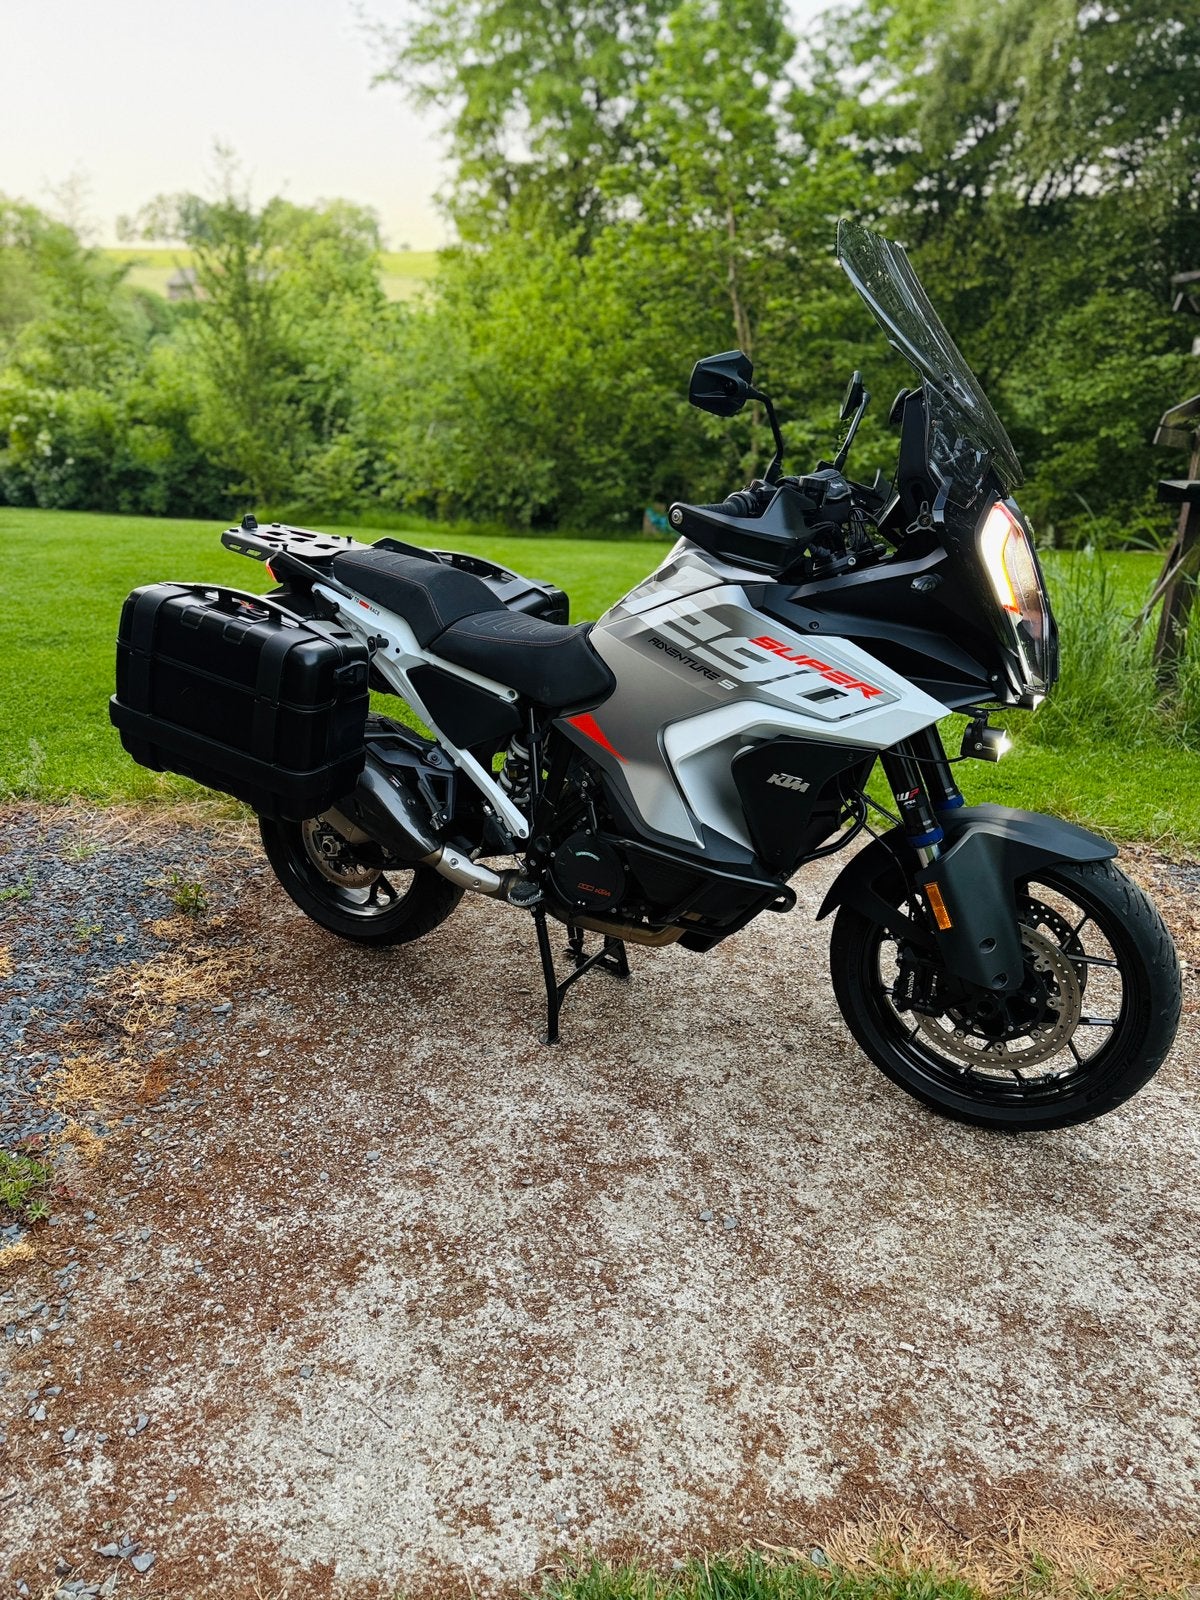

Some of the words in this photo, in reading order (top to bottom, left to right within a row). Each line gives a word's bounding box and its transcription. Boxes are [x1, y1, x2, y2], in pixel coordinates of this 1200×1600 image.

[647, 637, 721, 681] ADVENTURE
[717, 679, 739, 690] S
[748, 635, 884, 700] SUPER
[766, 772, 810, 793] KTM
[896, 787, 920, 801] WP
[905, 970, 915, 999] brembo
